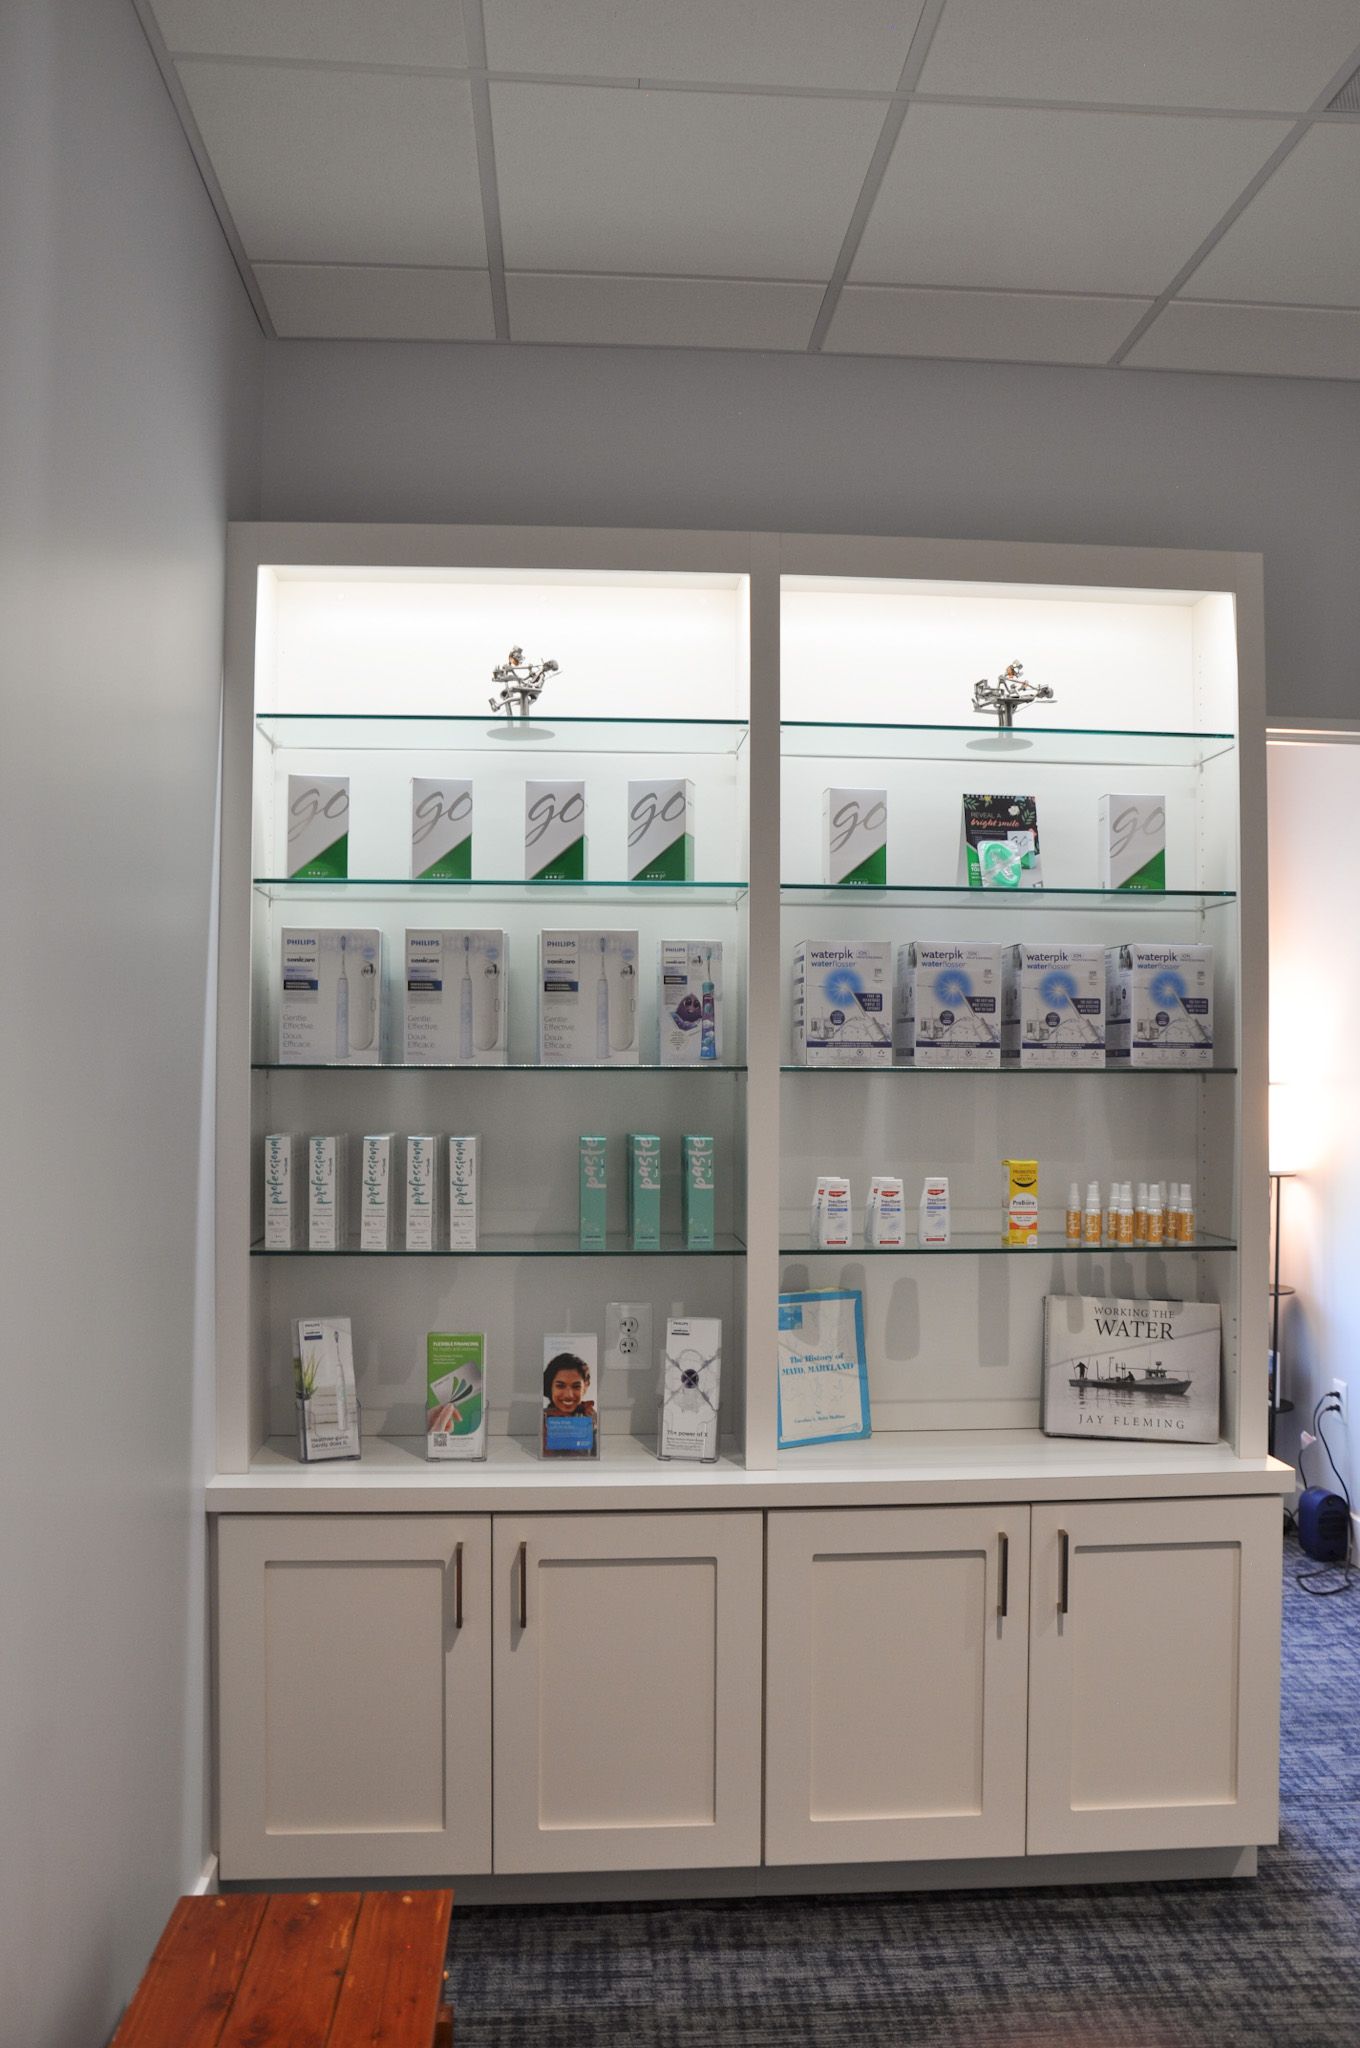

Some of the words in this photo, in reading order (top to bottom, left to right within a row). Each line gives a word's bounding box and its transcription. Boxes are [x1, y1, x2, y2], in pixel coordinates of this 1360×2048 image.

[287, 787, 349, 842] go
[412, 791, 473, 845] go
[525, 792, 584, 847] go
[628, 791, 686, 847] go
[969, 817, 997, 829] bright
[997, 819, 1020, 828] smile
[830, 801, 886, 852] go
[1110, 805, 1165, 858] go
[811, 946, 853, 961] waterpik
[921, 946, 963, 961] waterpik
[1026, 948, 1068, 962] waterpik
[1137, 949, 1178, 963] waterpik
[282, 1022, 314, 1030] Effective
[407, 1023, 439, 1031] Effective
[266, 1136, 288, 1204] professional
[310, 1136, 332, 1205] professional
[581, 1139, 607, 1189] paste
[635, 1139, 660, 1190] paste
[688, 1139, 714, 1190] paste
[1094, 1306, 1149, 1318] WORKING
[1152, 1309, 1175, 1319] THE
[1094, 1318, 1175, 1340] WATER
[789, 1355, 802, 1364] The
[804, 1353, 832, 1363] History
[835, 1352, 844, 1360] of
[808, 1362, 854, 1374] MARYLAND
[1079, 1413, 1104, 1425] JAY
[1113, 1416, 1185, 1430] FLEMING
